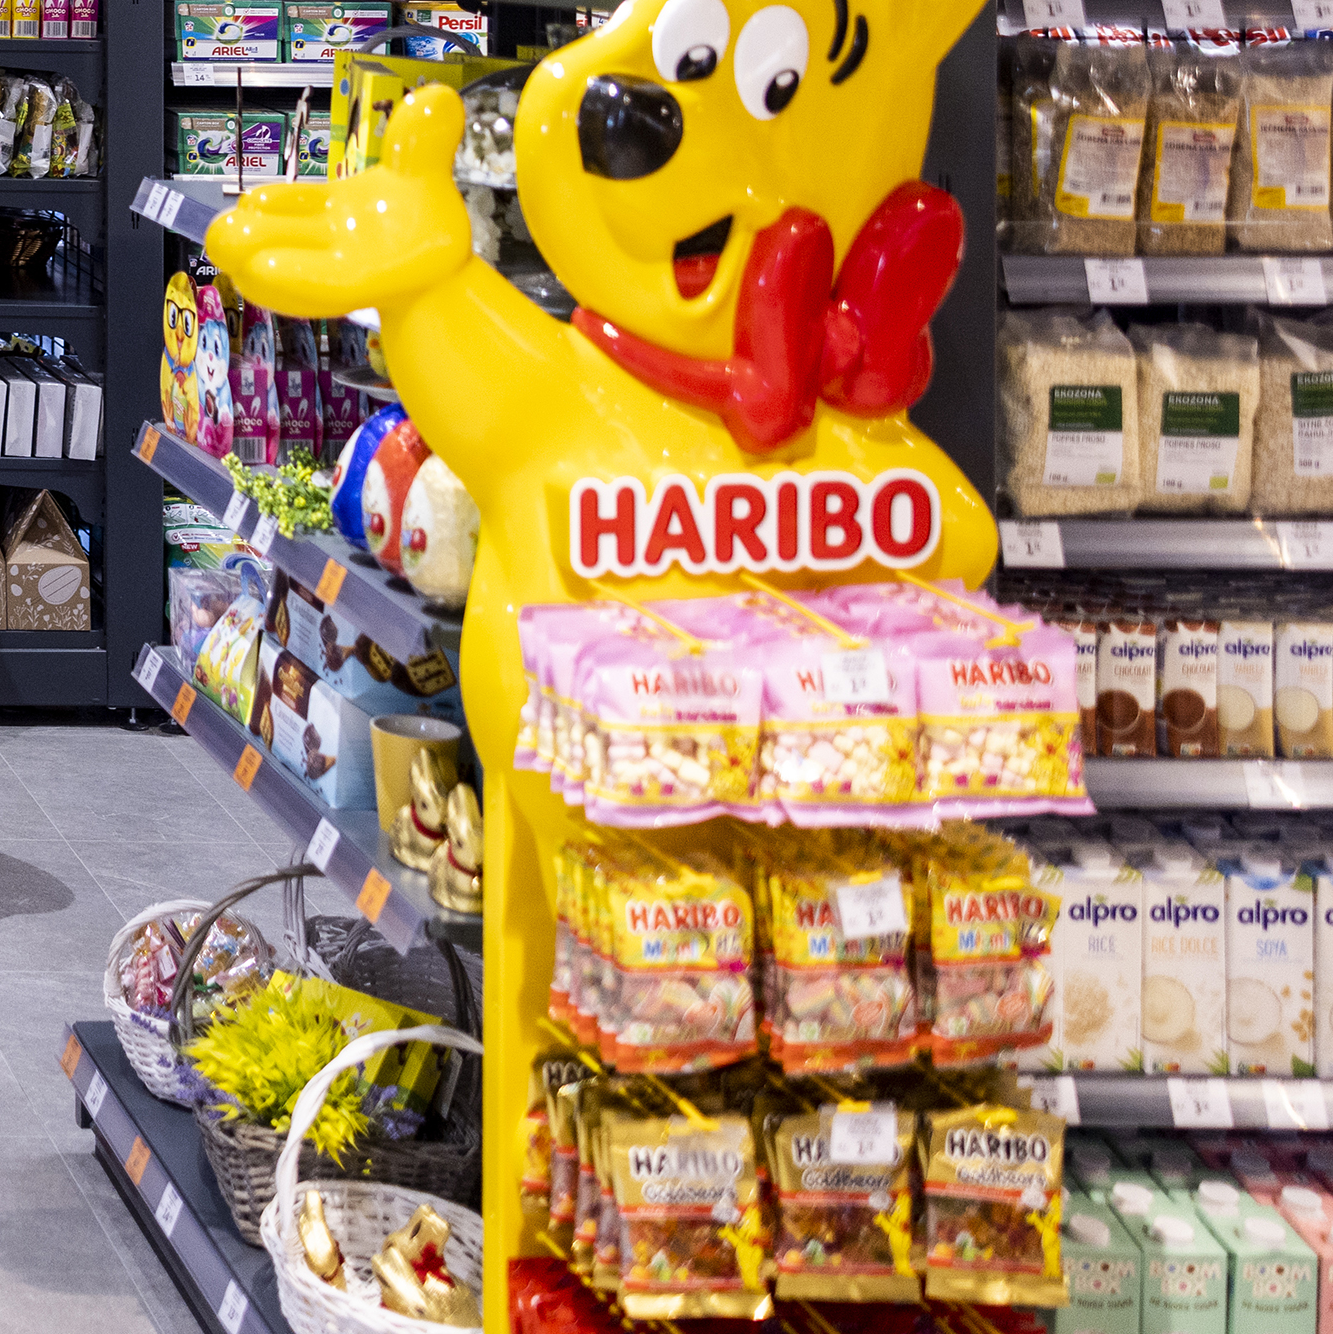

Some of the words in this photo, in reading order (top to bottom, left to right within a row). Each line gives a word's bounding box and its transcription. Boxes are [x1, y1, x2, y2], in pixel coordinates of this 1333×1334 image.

[439, 15, 482, 30] Persil
[212, 47, 248, 56] ARIEL
[197, 266, 223, 275] ARI
[579, 478, 933, 567] HARIBO
[1111, 642, 1155, 660] alpro
[1225, 639, 1270, 659] alpro
[1290, 640, 1333, 659] alpro
[950, 661, 1051, 686] HARIBO
[628, 902, 741, 931] HARIBO
[946, 894, 1046, 923] HARIBO
[1068, 896, 1138, 926] alpro
[1150, 896, 1219, 926] alpro
[1237, 900, 1308, 930] alpro
[1088, 936, 1116, 953] RICE
[1151, 937, 1177, 954] RICE
[1180, 936, 1218, 954] DOLCE
[1257, 940, 1287, 958] SOYA
[947, 1129, 1050, 1160] HARIBO
